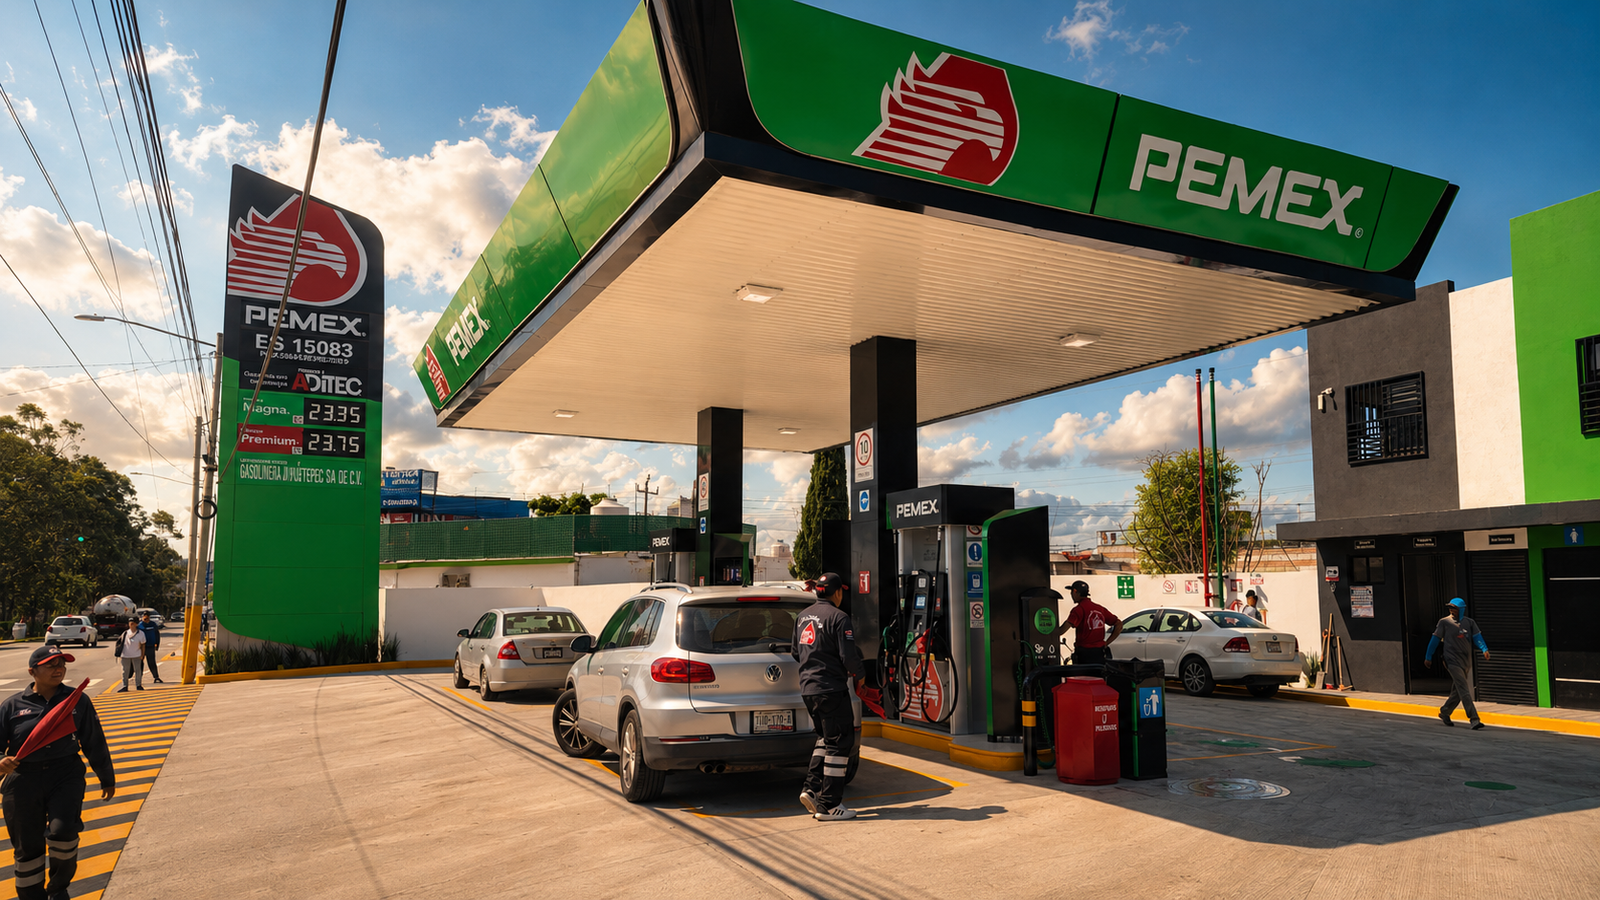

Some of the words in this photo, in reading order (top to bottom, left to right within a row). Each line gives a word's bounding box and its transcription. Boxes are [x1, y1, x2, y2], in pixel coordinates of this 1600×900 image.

[1129, 133, 1364, 236] PEMEX
[245, 304, 362, 337] PEMEX
[445, 296, 489, 367] PEMEX
[255, 333, 285, 351] ES
[292, 338, 354, 358] 15083
[309, 402, 361, 424] 23.35
[308, 433, 360, 453] 23.75
[860, 439, 869, 455] 10
[326, 468, 337, 484] SA
[338, 469, 348, 485] DE
[896, 498, 938, 519] PEMEX
